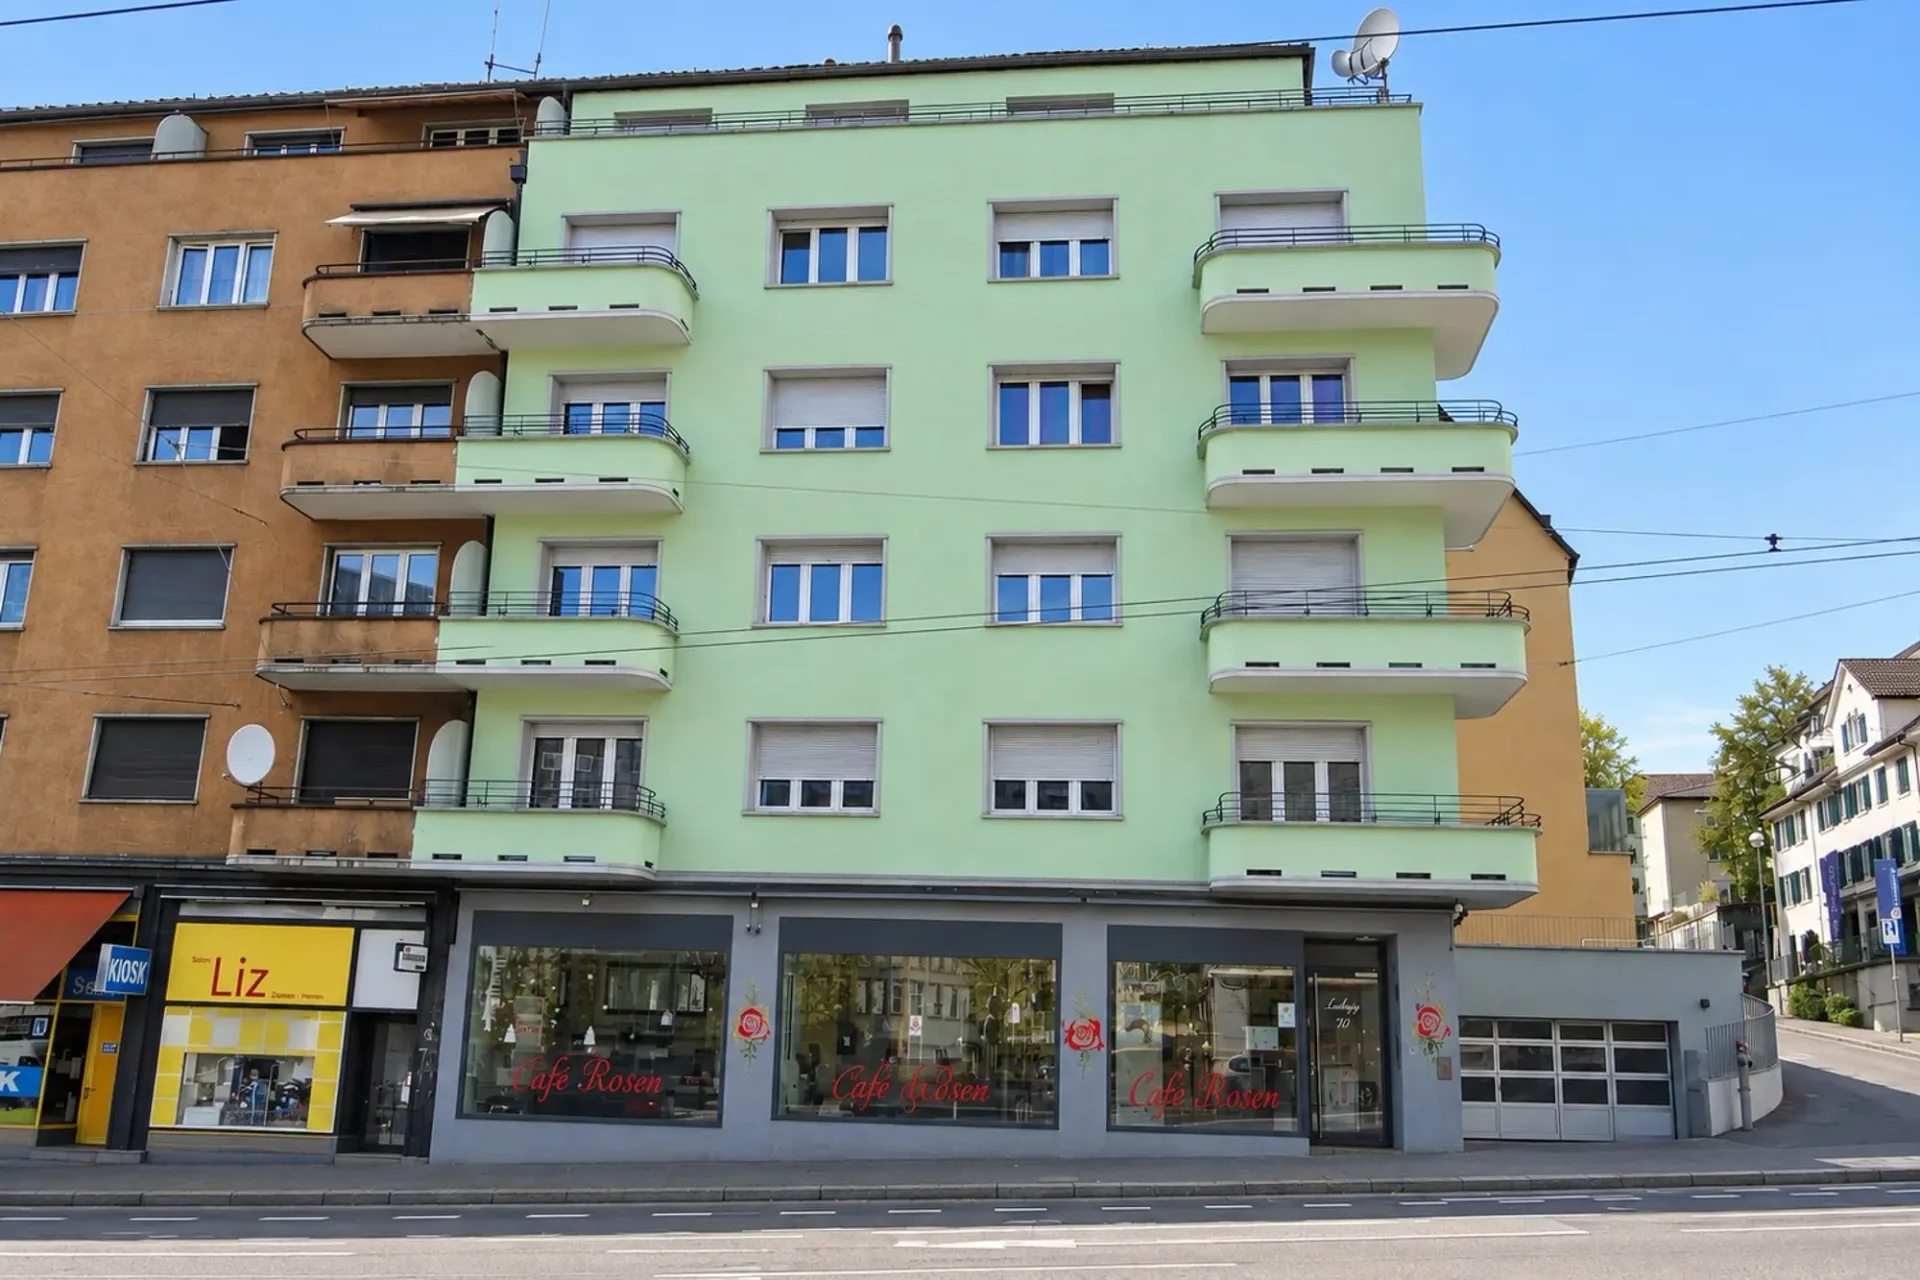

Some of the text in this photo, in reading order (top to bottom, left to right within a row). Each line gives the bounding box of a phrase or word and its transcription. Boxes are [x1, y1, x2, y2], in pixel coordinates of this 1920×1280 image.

[108, 958, 148, 985] KIOSK
[211, 957, 269, 997] Liz
[512, 1053, 662, 1102] Café Rosen
[832, 1061, 891, 1111] Café
[1194, 1071, 1280, 1110] Rosen
